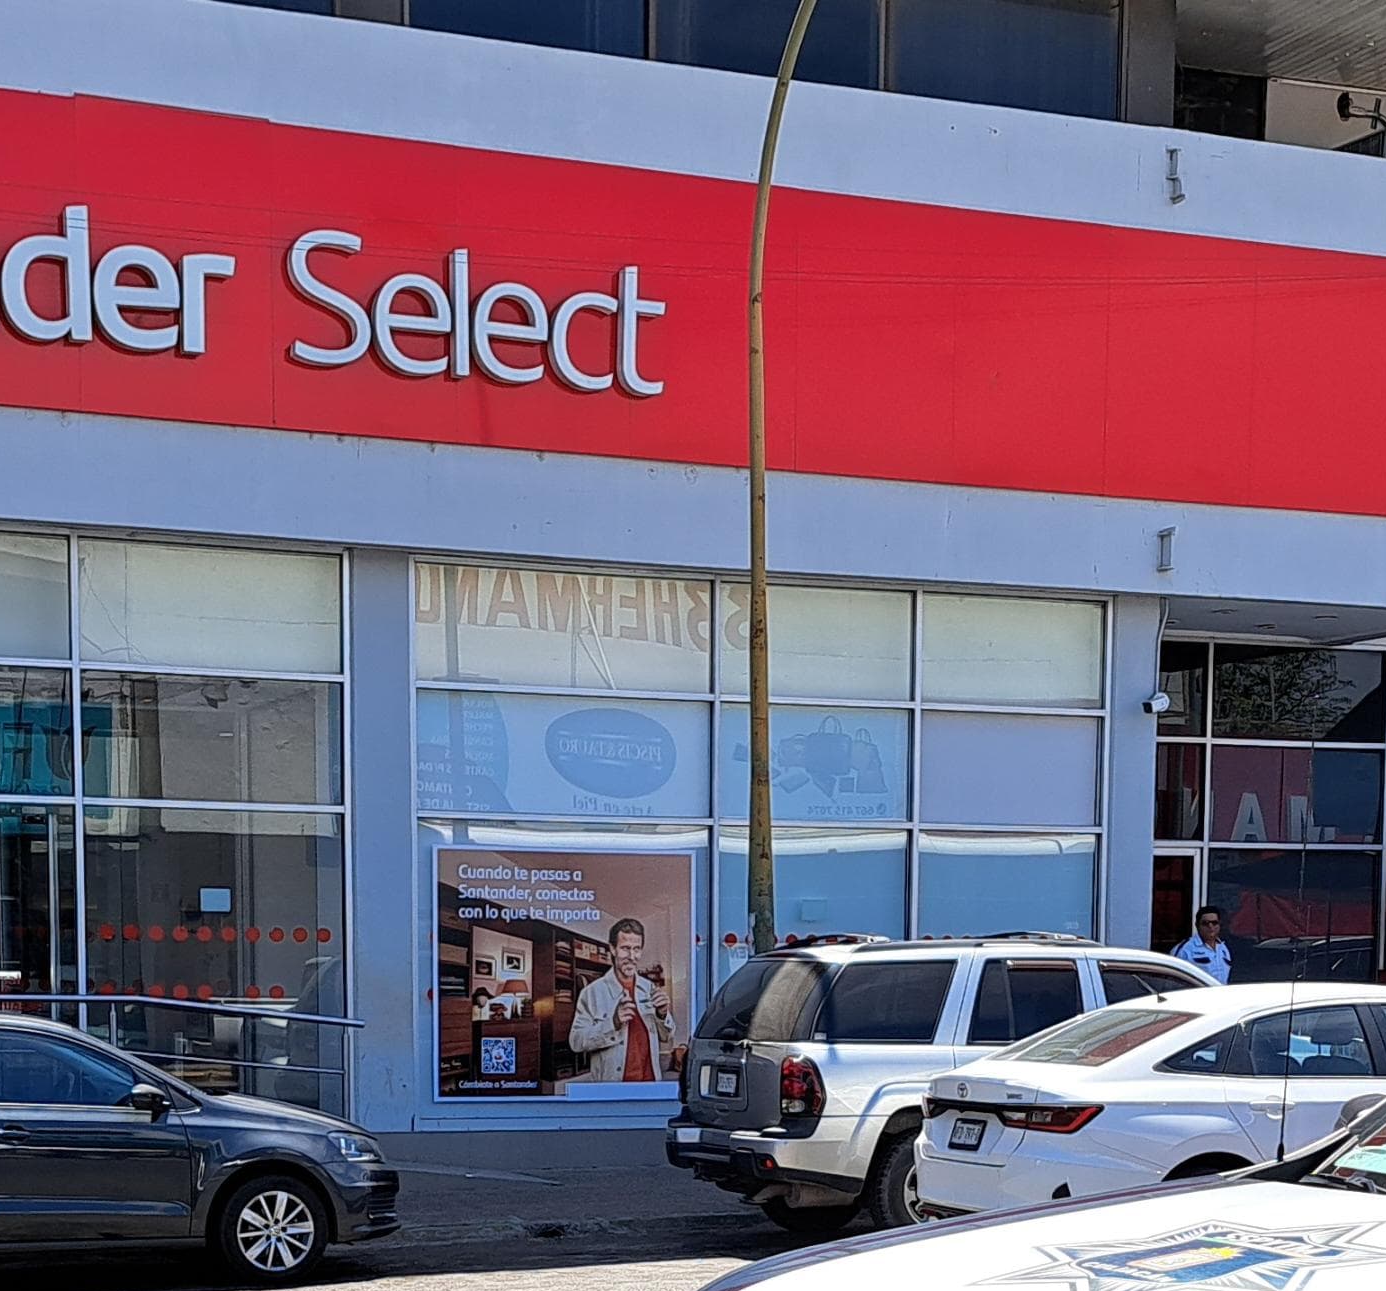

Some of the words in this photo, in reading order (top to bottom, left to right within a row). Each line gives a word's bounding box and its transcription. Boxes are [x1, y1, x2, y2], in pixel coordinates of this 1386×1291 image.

[286, 229, 667, 397] Select
[458, 864, 512, 880] Cuando
[514, 866, 529, 880] te
[531, 869, 570, 883] pasas
[572, 870, 582, 882] a
[458, 883, 533, 902] Santander,
[535, 887, 595, 901] conectas
[458, 906, 483, 918] con
[485, 904, 499, 918] lo
[500, 908, 530, 923] que
[530, 906, 544, 920] te
[546, 905, 601, 923] importa
